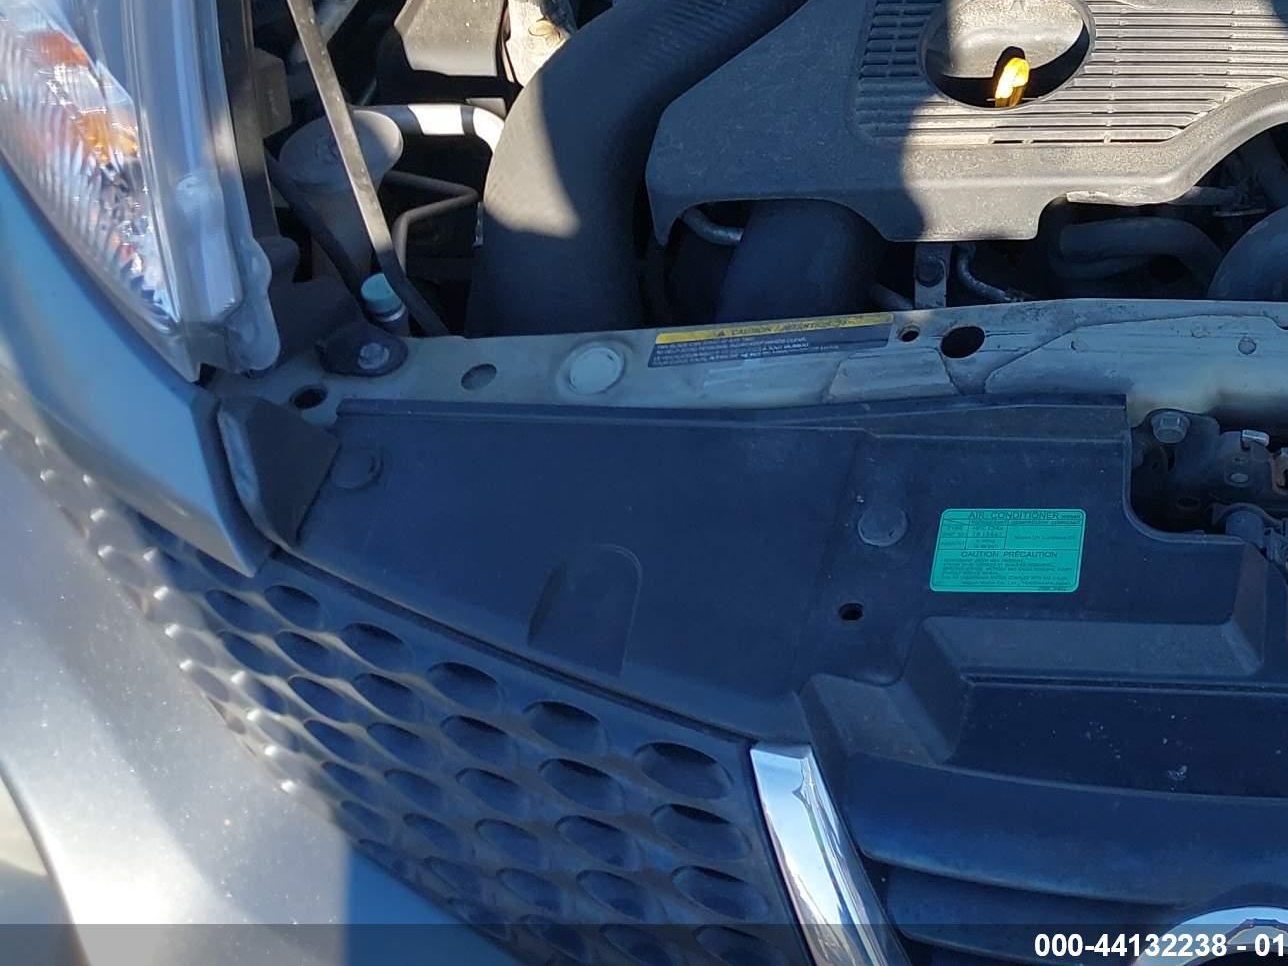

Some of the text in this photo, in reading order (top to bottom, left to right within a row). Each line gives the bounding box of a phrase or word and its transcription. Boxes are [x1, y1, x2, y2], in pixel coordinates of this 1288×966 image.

[968, 512, 985, 520] AIR
[990, 511, 1059, 520] CONDITIONER
[960, 550, 999, 558] CAUTION
